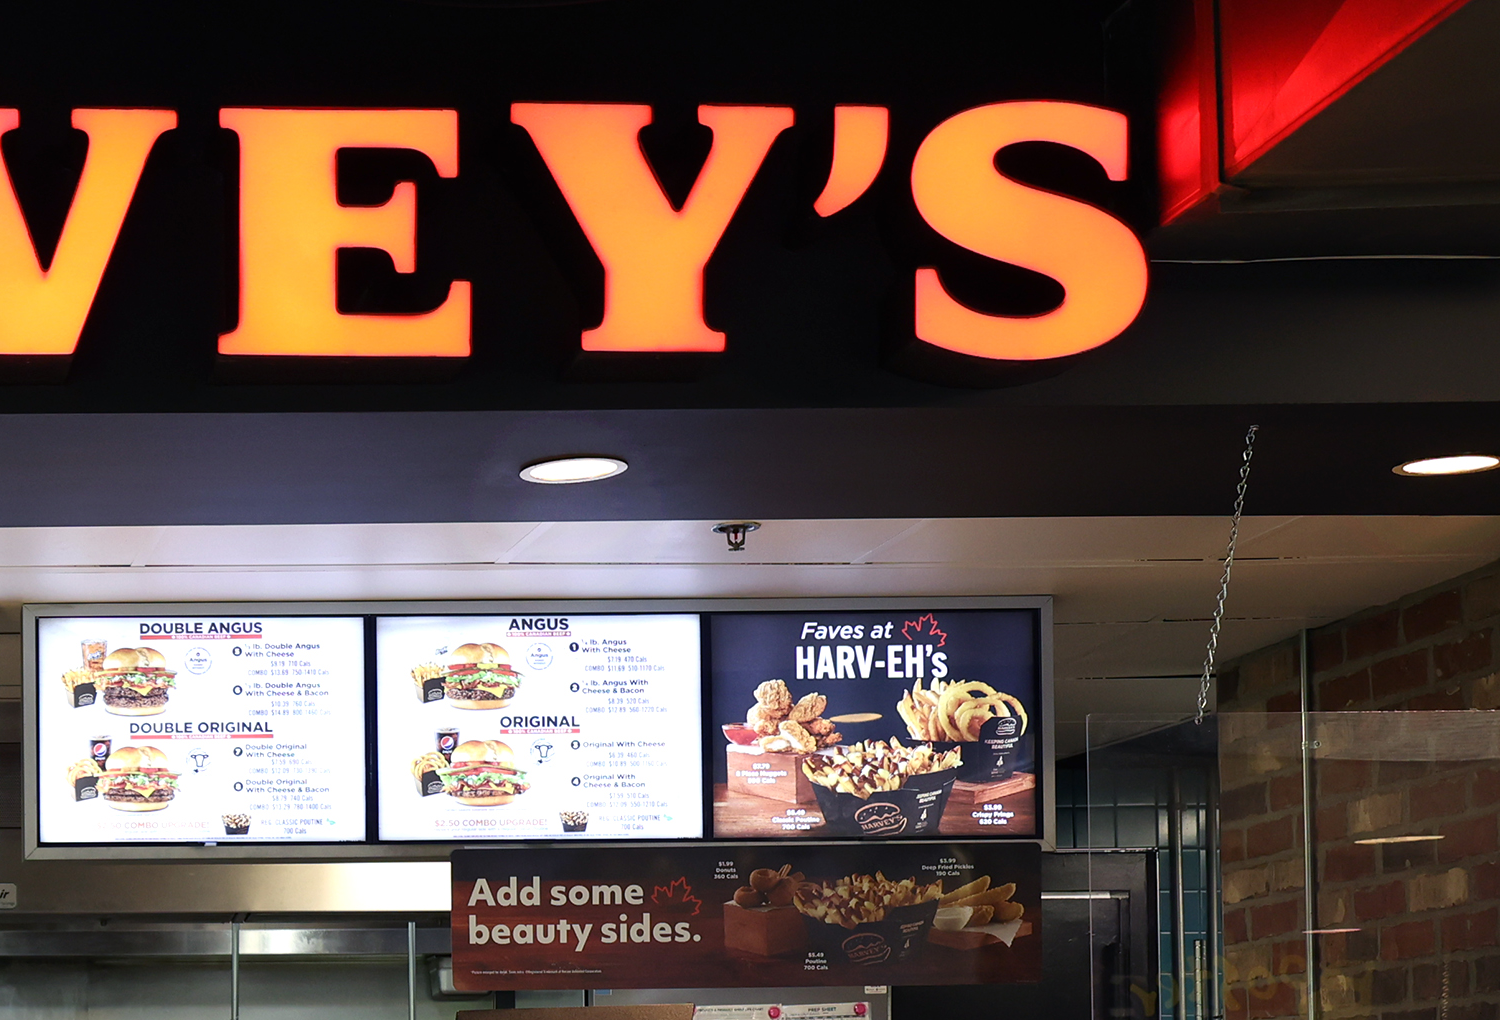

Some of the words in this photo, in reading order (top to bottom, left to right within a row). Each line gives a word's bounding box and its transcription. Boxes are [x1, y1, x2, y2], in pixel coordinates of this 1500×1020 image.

[140, 623, 203, 634] DOUBLE
[208, 622, 262, 633] ANGUS
[508, 618, 569, 630] ANGUS
[801, 622, 863, 639] Faves
[871, 623, 893, 639] at
[295, 643, 320, 651] Angus
[796, 645, 948, 679] HARV-EH's
[130, 723, 192, 734] DOUBLE
[198, 722, 273, 733] ORIGINAL
[500, 716, 580, 728] ORIGINAL
[435, 819, 459, 827] $2.50
[462, 819, 496, 827] COMBO
[499, 819, 547, 827] UPGRADE!
[861, 815, 902, 831] HARVEY'S
[468, 877, 544, 906] Add
[550, 885, 643, 905] some
[469, 915, 589, 952] beauty
[600, 913, 701, 943] sides.
